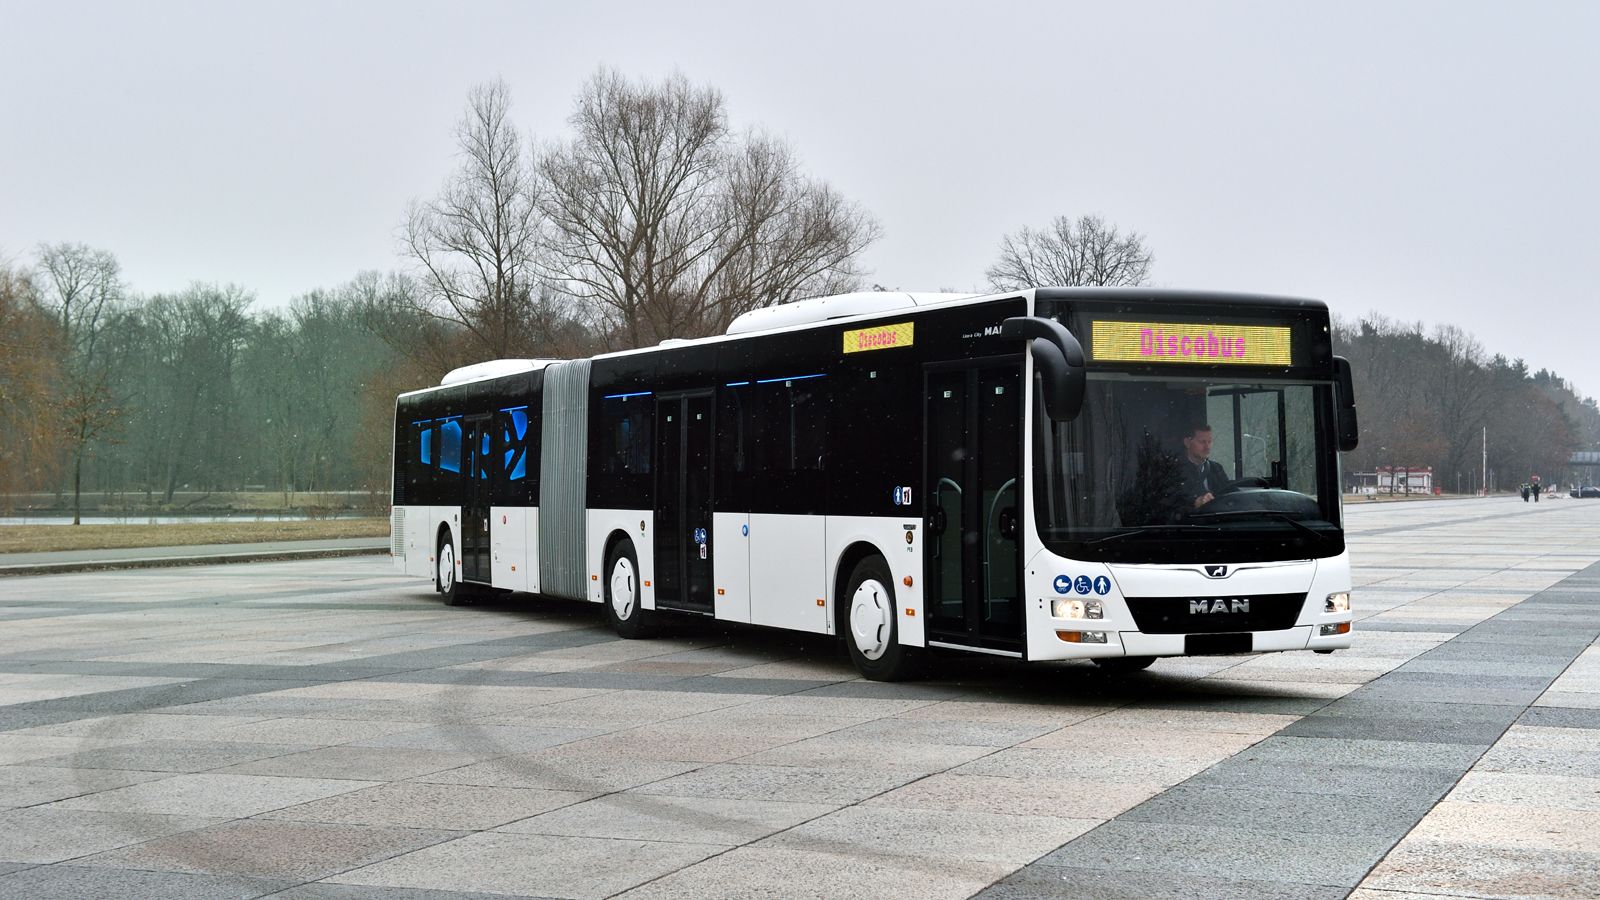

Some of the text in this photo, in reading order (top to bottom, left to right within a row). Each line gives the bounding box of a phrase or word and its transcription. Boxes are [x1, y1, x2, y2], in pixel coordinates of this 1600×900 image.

[858, 330, 896, 349] Discobus
[1139, 328, 1246, 358] Discobus
[1189, 598, 1250, 615] MAN
